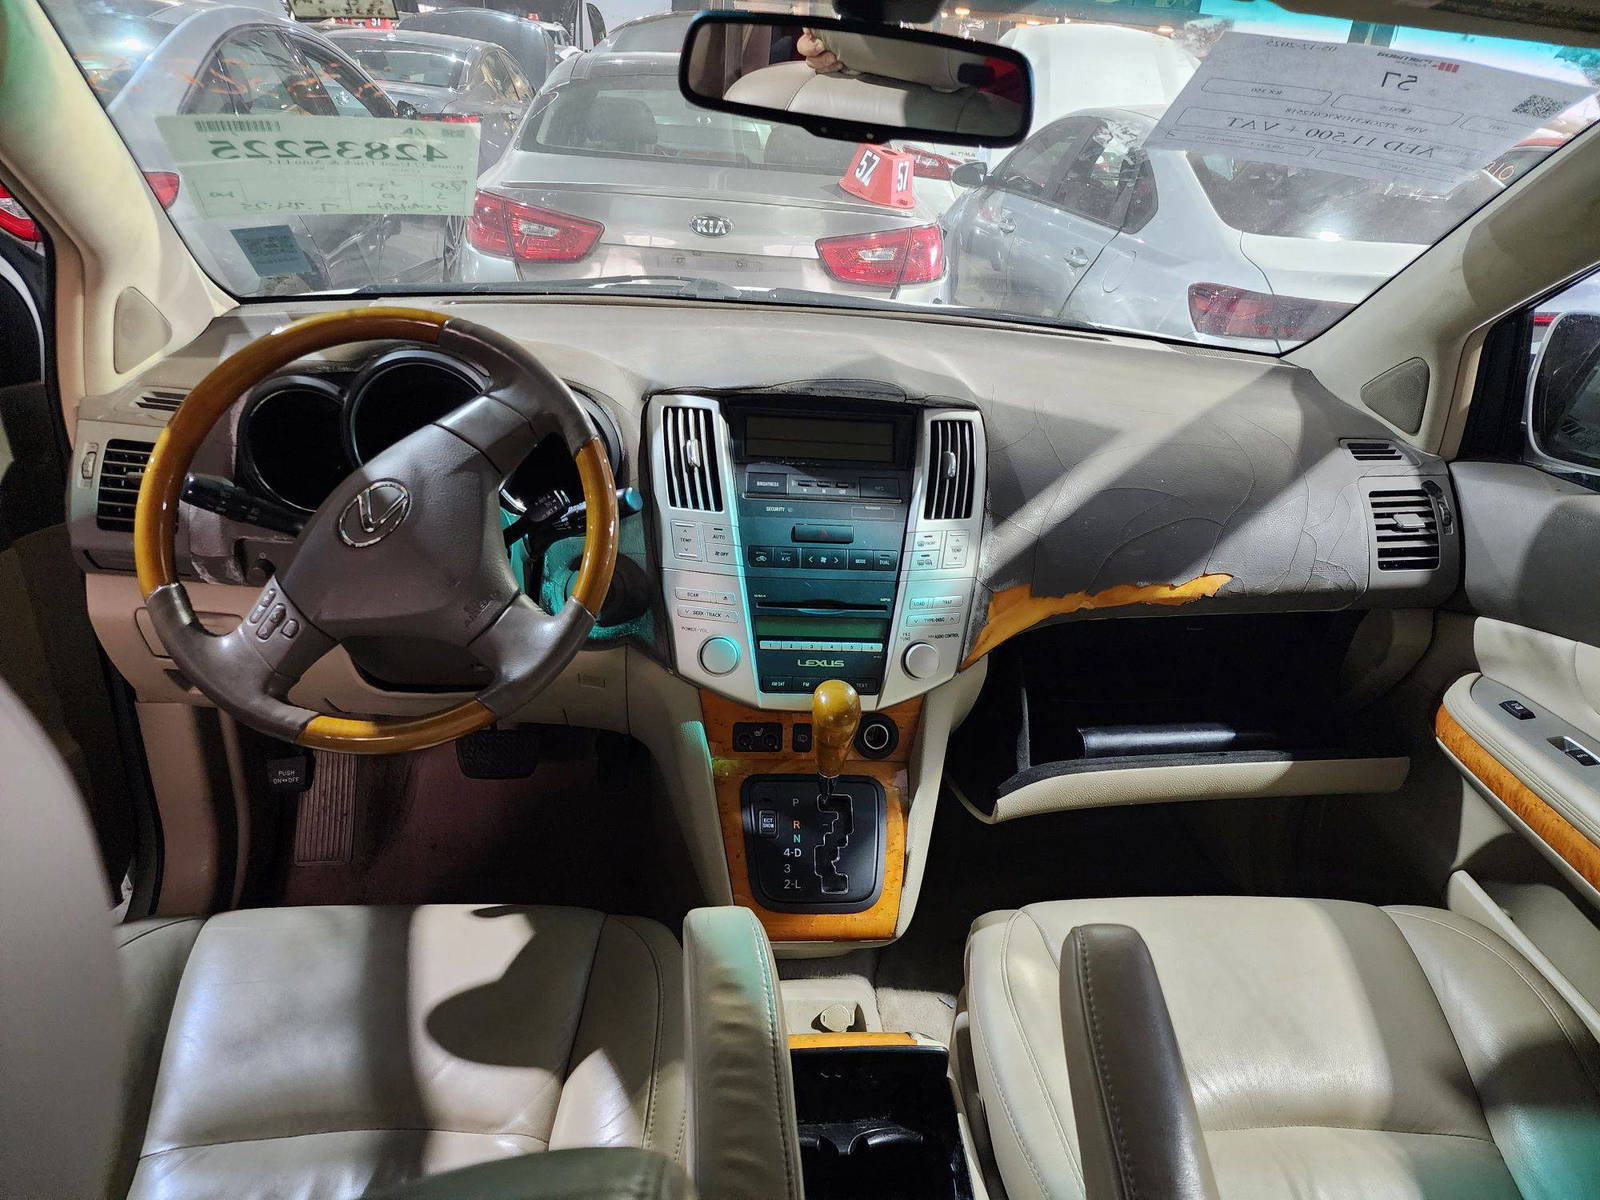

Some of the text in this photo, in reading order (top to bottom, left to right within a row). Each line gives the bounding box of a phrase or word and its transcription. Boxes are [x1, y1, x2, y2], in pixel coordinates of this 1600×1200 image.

[854, 150, 881, 187] 57
[896, 160, 910, 193] 57
[696, 219, 727, 234] KIA
[797, 659, 845, 668] LEXUS
[792, 798, 799, 806] P
[792, 820, 800, 829] R
[793, 834, 801, 843] N
[783, 848, 802, 858] 4-D
[783, 863, 791, 873] 3
[783, 879, 801, 889] 2-L
